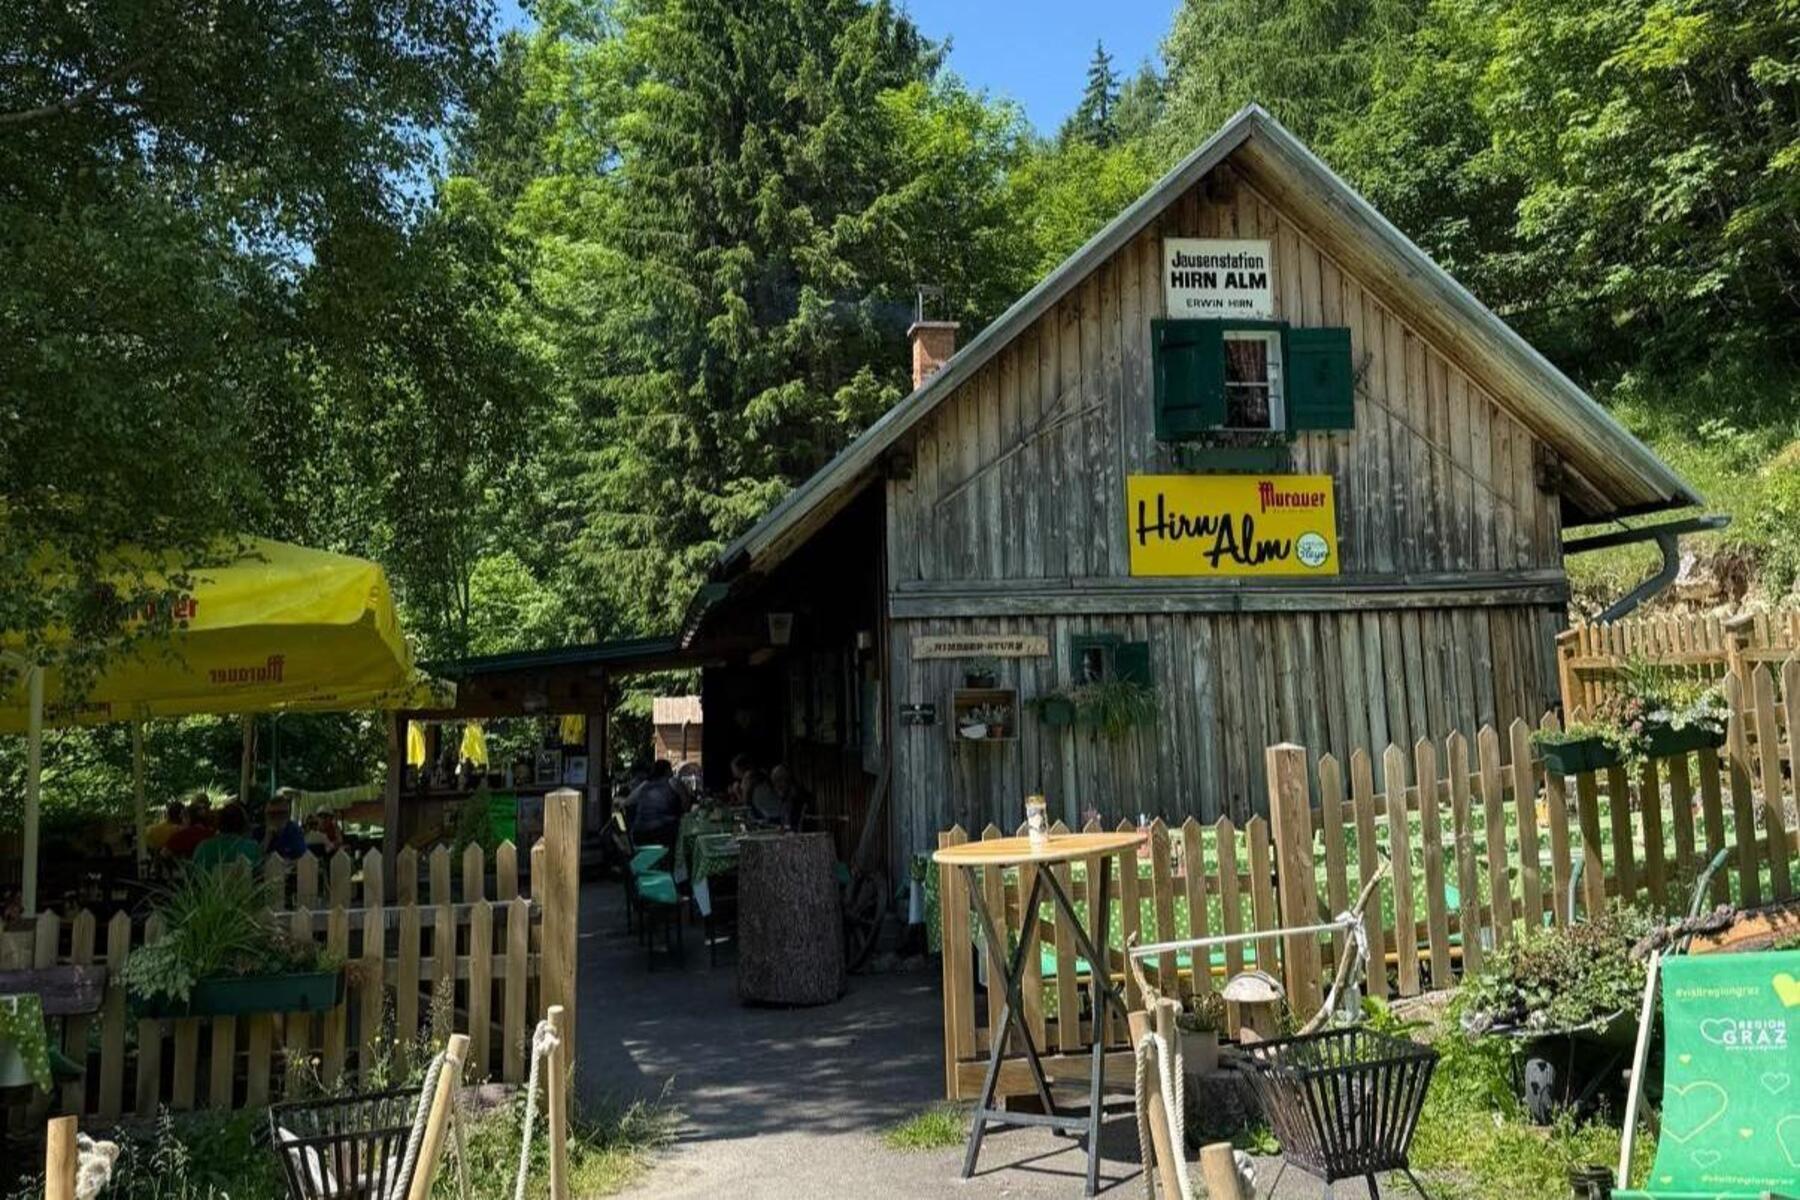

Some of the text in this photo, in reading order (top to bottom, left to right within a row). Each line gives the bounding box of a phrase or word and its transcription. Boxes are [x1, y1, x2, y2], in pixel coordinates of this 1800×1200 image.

[1171, 250, 1264, 269] Jausenstation
[1171, 271, 1267, 289] HIRN ALM
[1186, 299, 1253, 308] ERWIN HIRN
[1258, 480, 1326, 513] Murauer
[1136, 493, 1218, 546] Hirn
[1203, 513, 1291, 568] Alm
[1738, 1018, 1786, 1029] REGION
[1723, 1030, 1787, 1044] GRAZ
